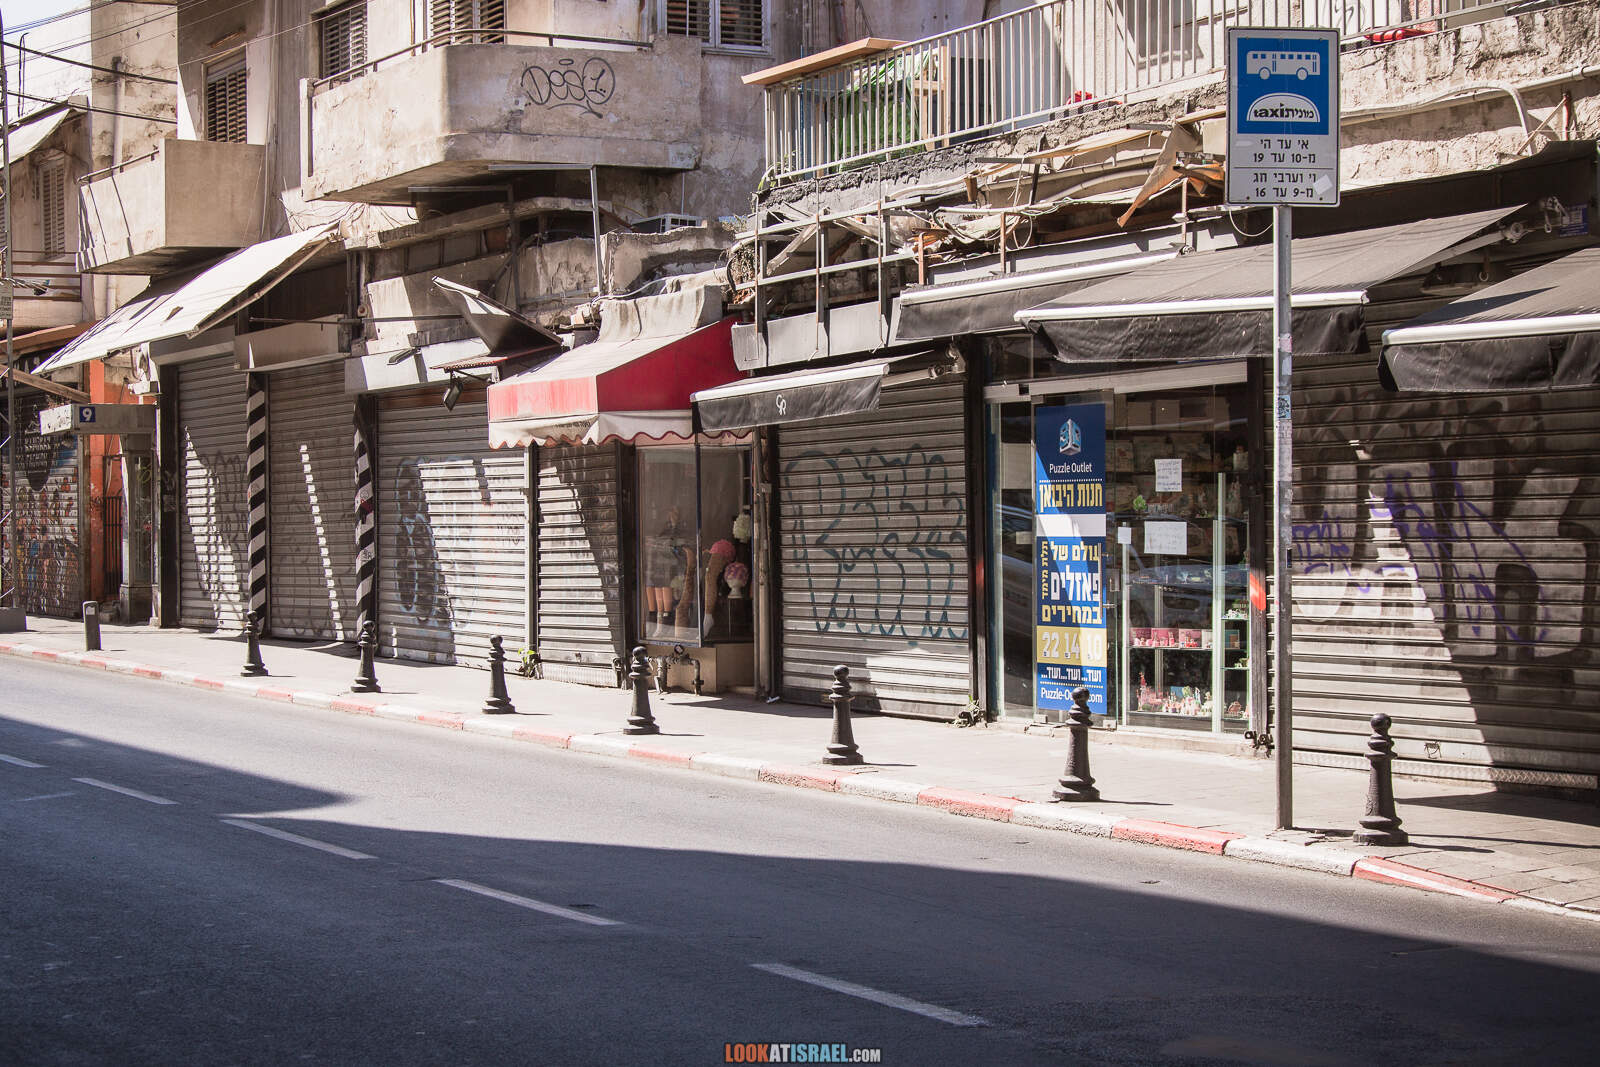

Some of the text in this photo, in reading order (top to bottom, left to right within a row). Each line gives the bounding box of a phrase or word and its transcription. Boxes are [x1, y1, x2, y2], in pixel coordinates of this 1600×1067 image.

[1254, 103, 1284, 118] taxi
[1285, 108, 1314, 118] מונית
[1277, 139, 1291, 149] עד
[1254, 153, 1316, 163] מ-10 עד 19
[1253, 172, 1267, 183] חג
[1273, 173, 1303, 183] וערבי
[1256, 187, 1313, 198] מ-9 עד 16
[82, 408, 92, 421] 9
[1049, 462, 1092, 473] Puzzle Outlet
[1039, 483, 1103, 512] חנות היבואן
[1050, 541, 1100, 562] עולם של
[1041, 541, 1049, 600] תלת מימד
[1050, 565, 1101, 602] פאזלים
[1042, 605, 1103, 625] במחירים
[1042, 631, 1102, 660] 10 14 22
